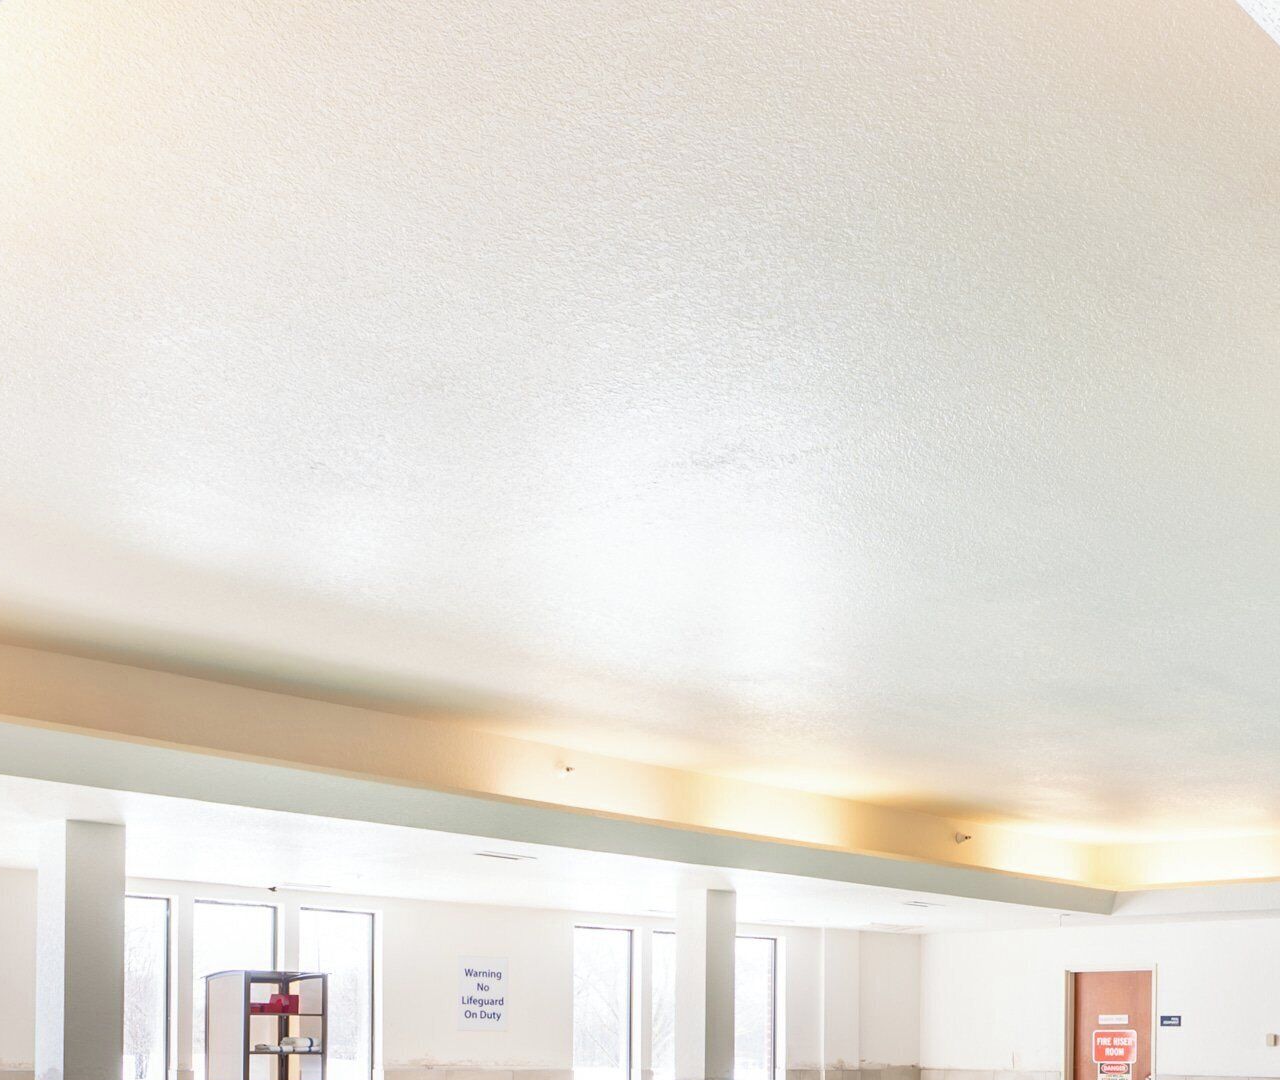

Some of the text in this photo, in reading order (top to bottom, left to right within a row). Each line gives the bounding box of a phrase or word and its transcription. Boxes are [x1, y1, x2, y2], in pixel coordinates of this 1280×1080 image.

[464, 968, 502, 981] Warning
[476, 982, 490, 992] No
[461, 996, 504, 1007] Lifeguard
[464, 1009, 502, 1021] On Duty
[1096, 1037, 1111, 1046] FIRE
[1104, 1047, 1125, 1056] ROOM
